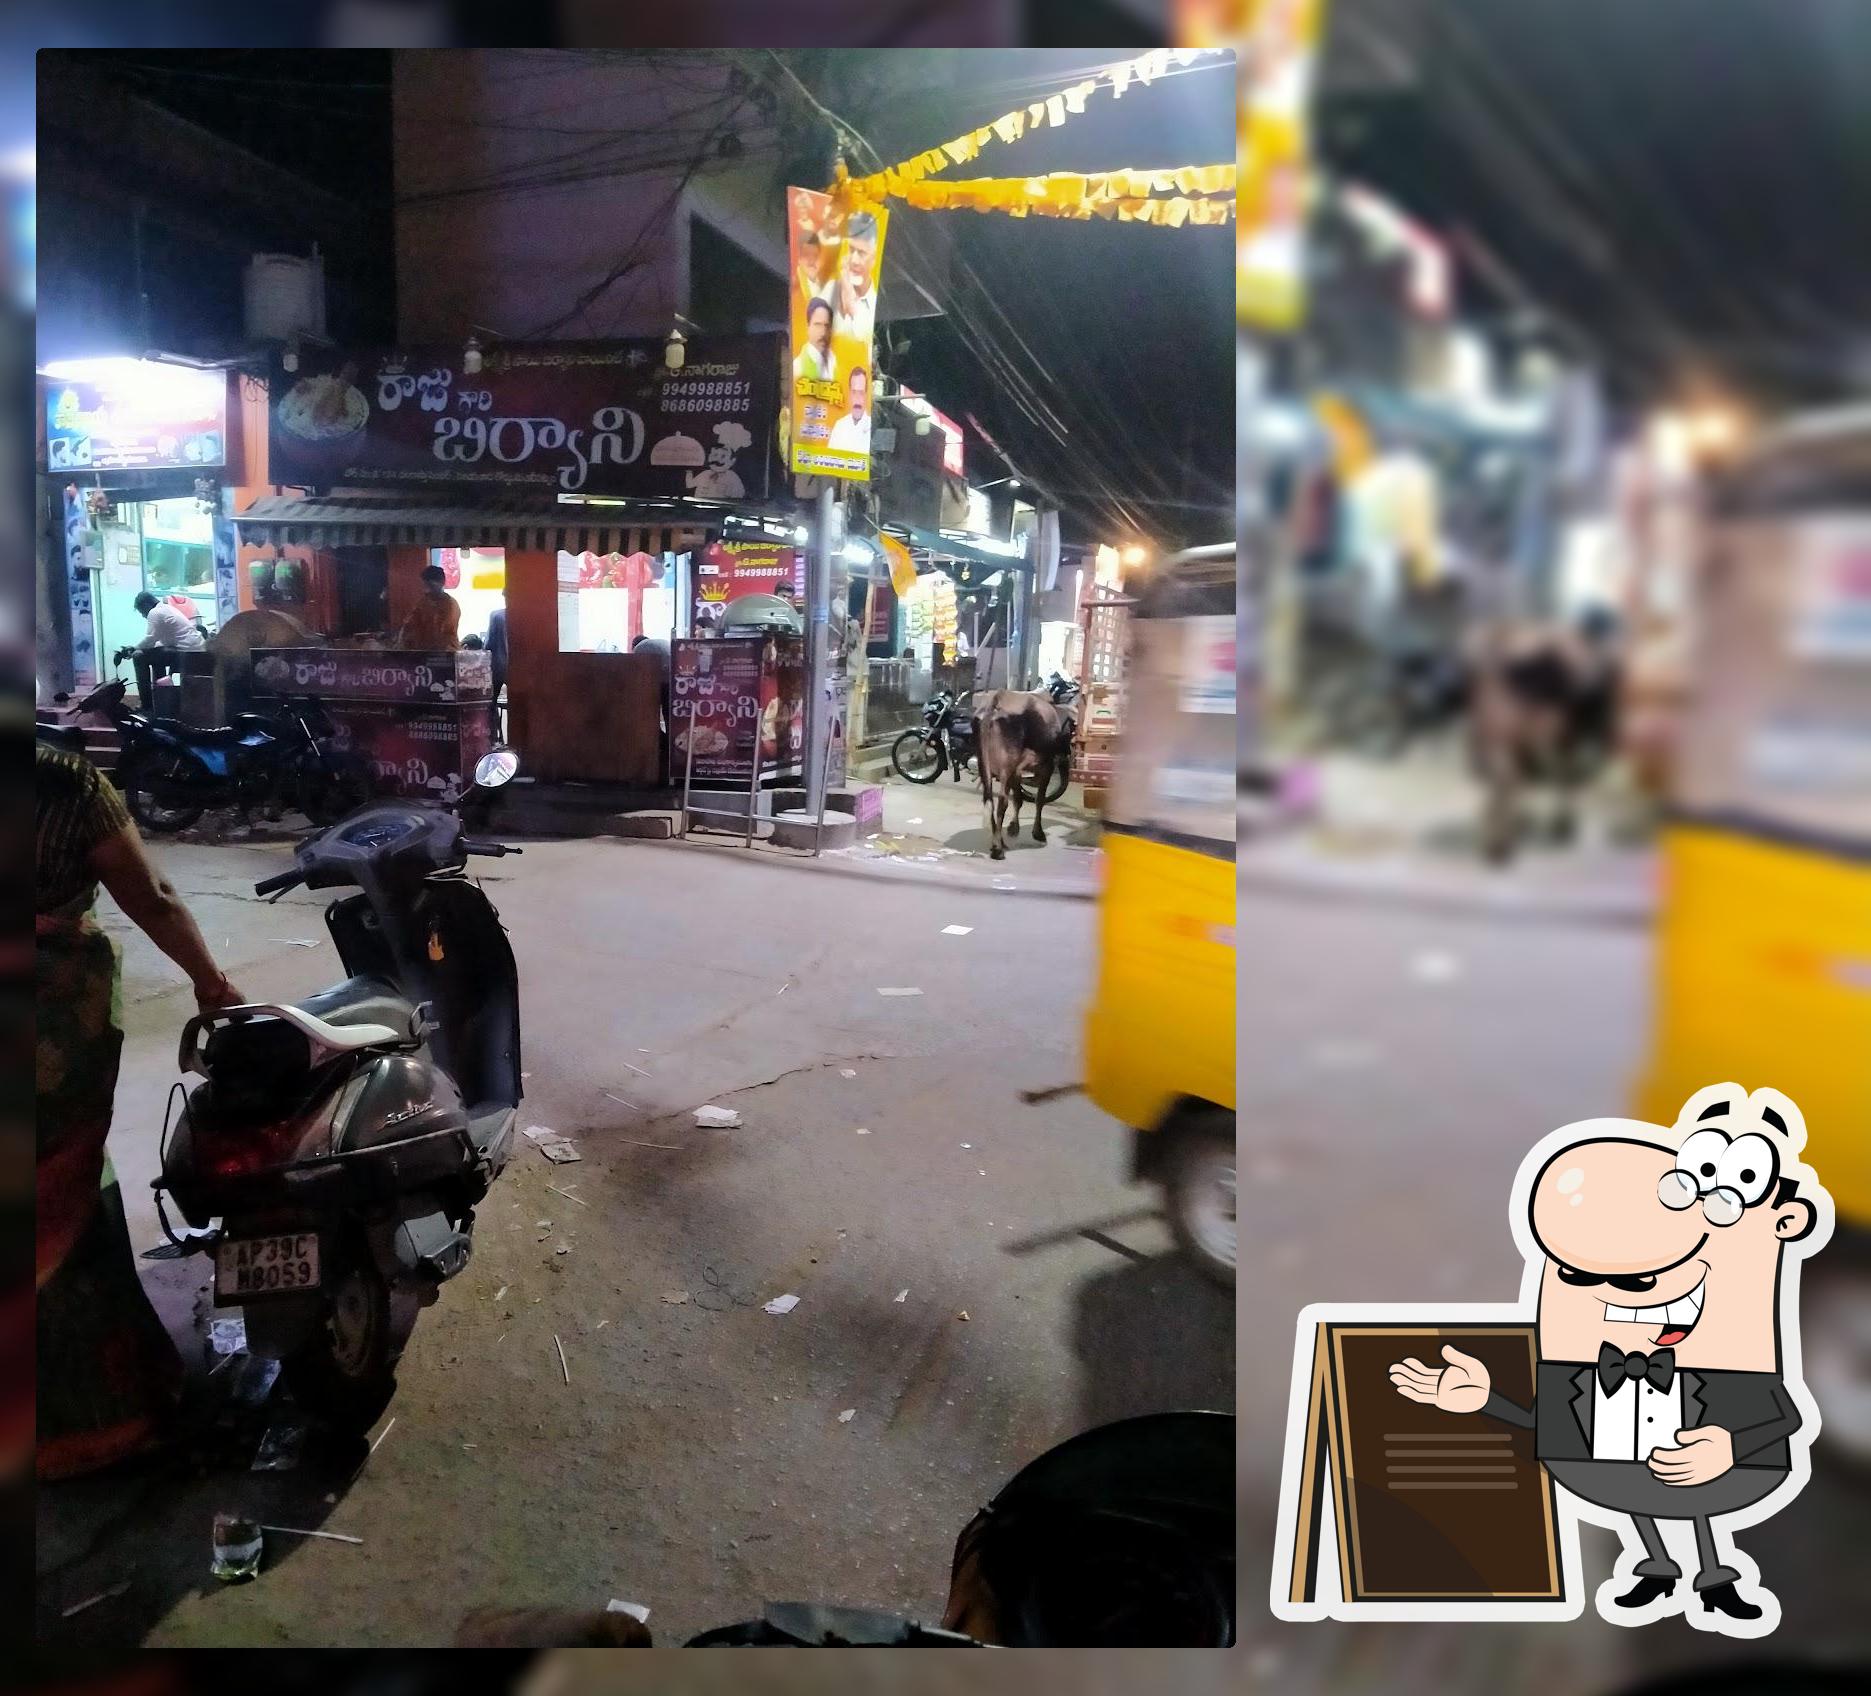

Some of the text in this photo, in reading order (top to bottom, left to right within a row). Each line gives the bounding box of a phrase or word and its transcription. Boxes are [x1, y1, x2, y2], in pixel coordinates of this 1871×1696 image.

[376, 367, 452, 412] రాజు
[661, 382, 751, 397] 9949988851
[661, 399, 750, 413] 8686098885
